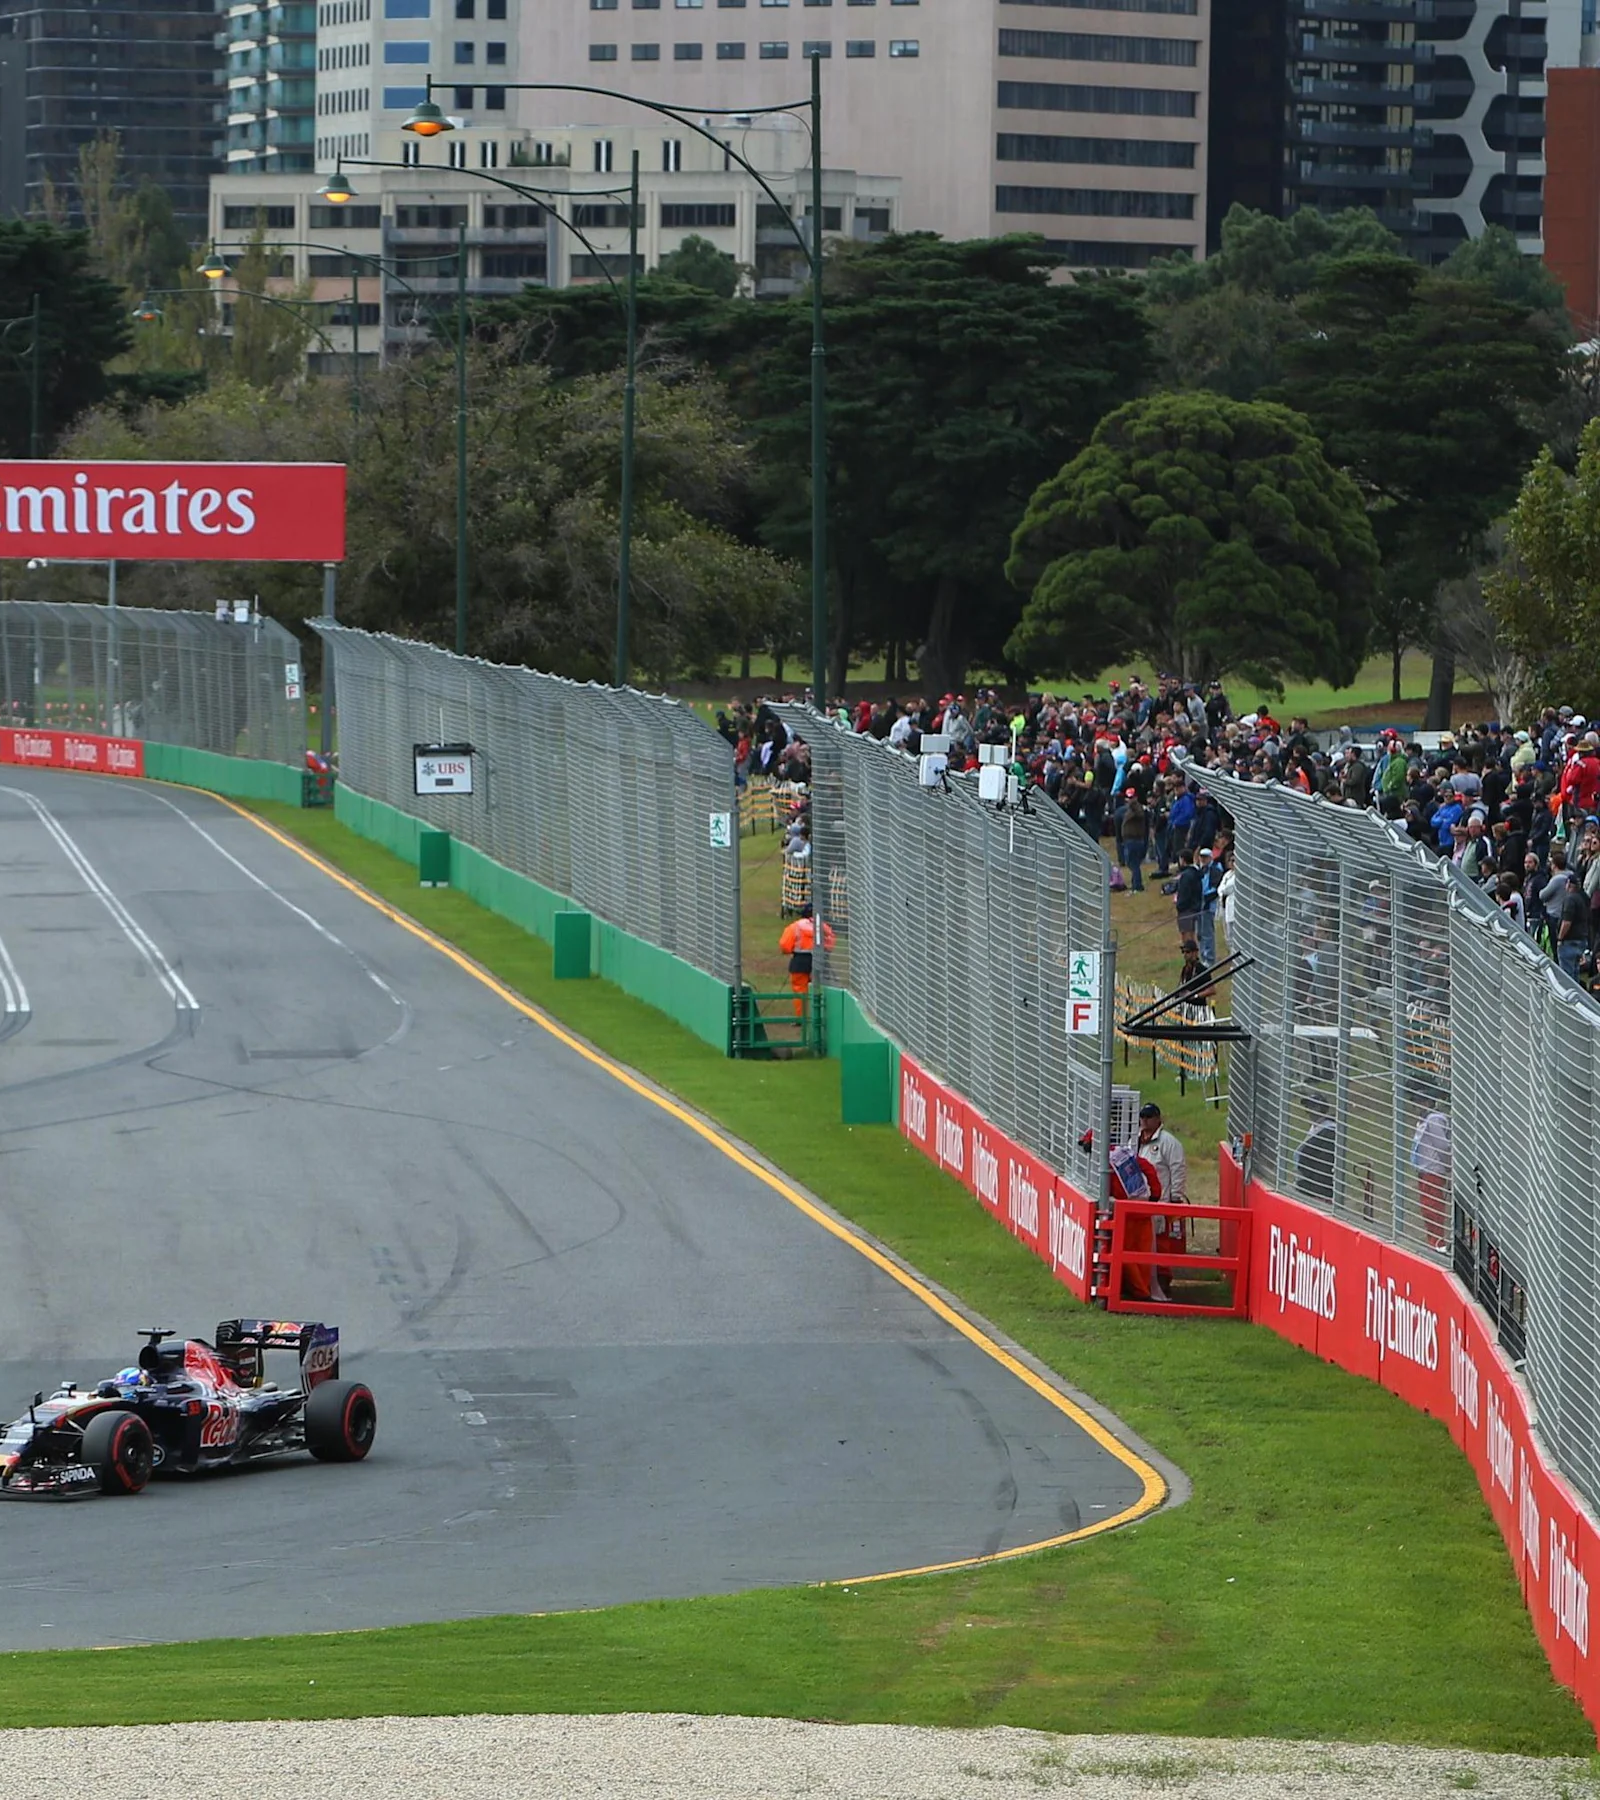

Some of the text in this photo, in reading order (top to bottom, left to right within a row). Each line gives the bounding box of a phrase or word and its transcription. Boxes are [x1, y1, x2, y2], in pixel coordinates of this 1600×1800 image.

[437, 762, 465, 774] UBS
[1072, 1004, 1091, 1030] F
[1049, 1189, 1085, 1280] Fly Emirates
[1269, 1224, 1336, 1321] Fly Emirates
[1366, 1266, 1438, 1371] Fly Emirates
